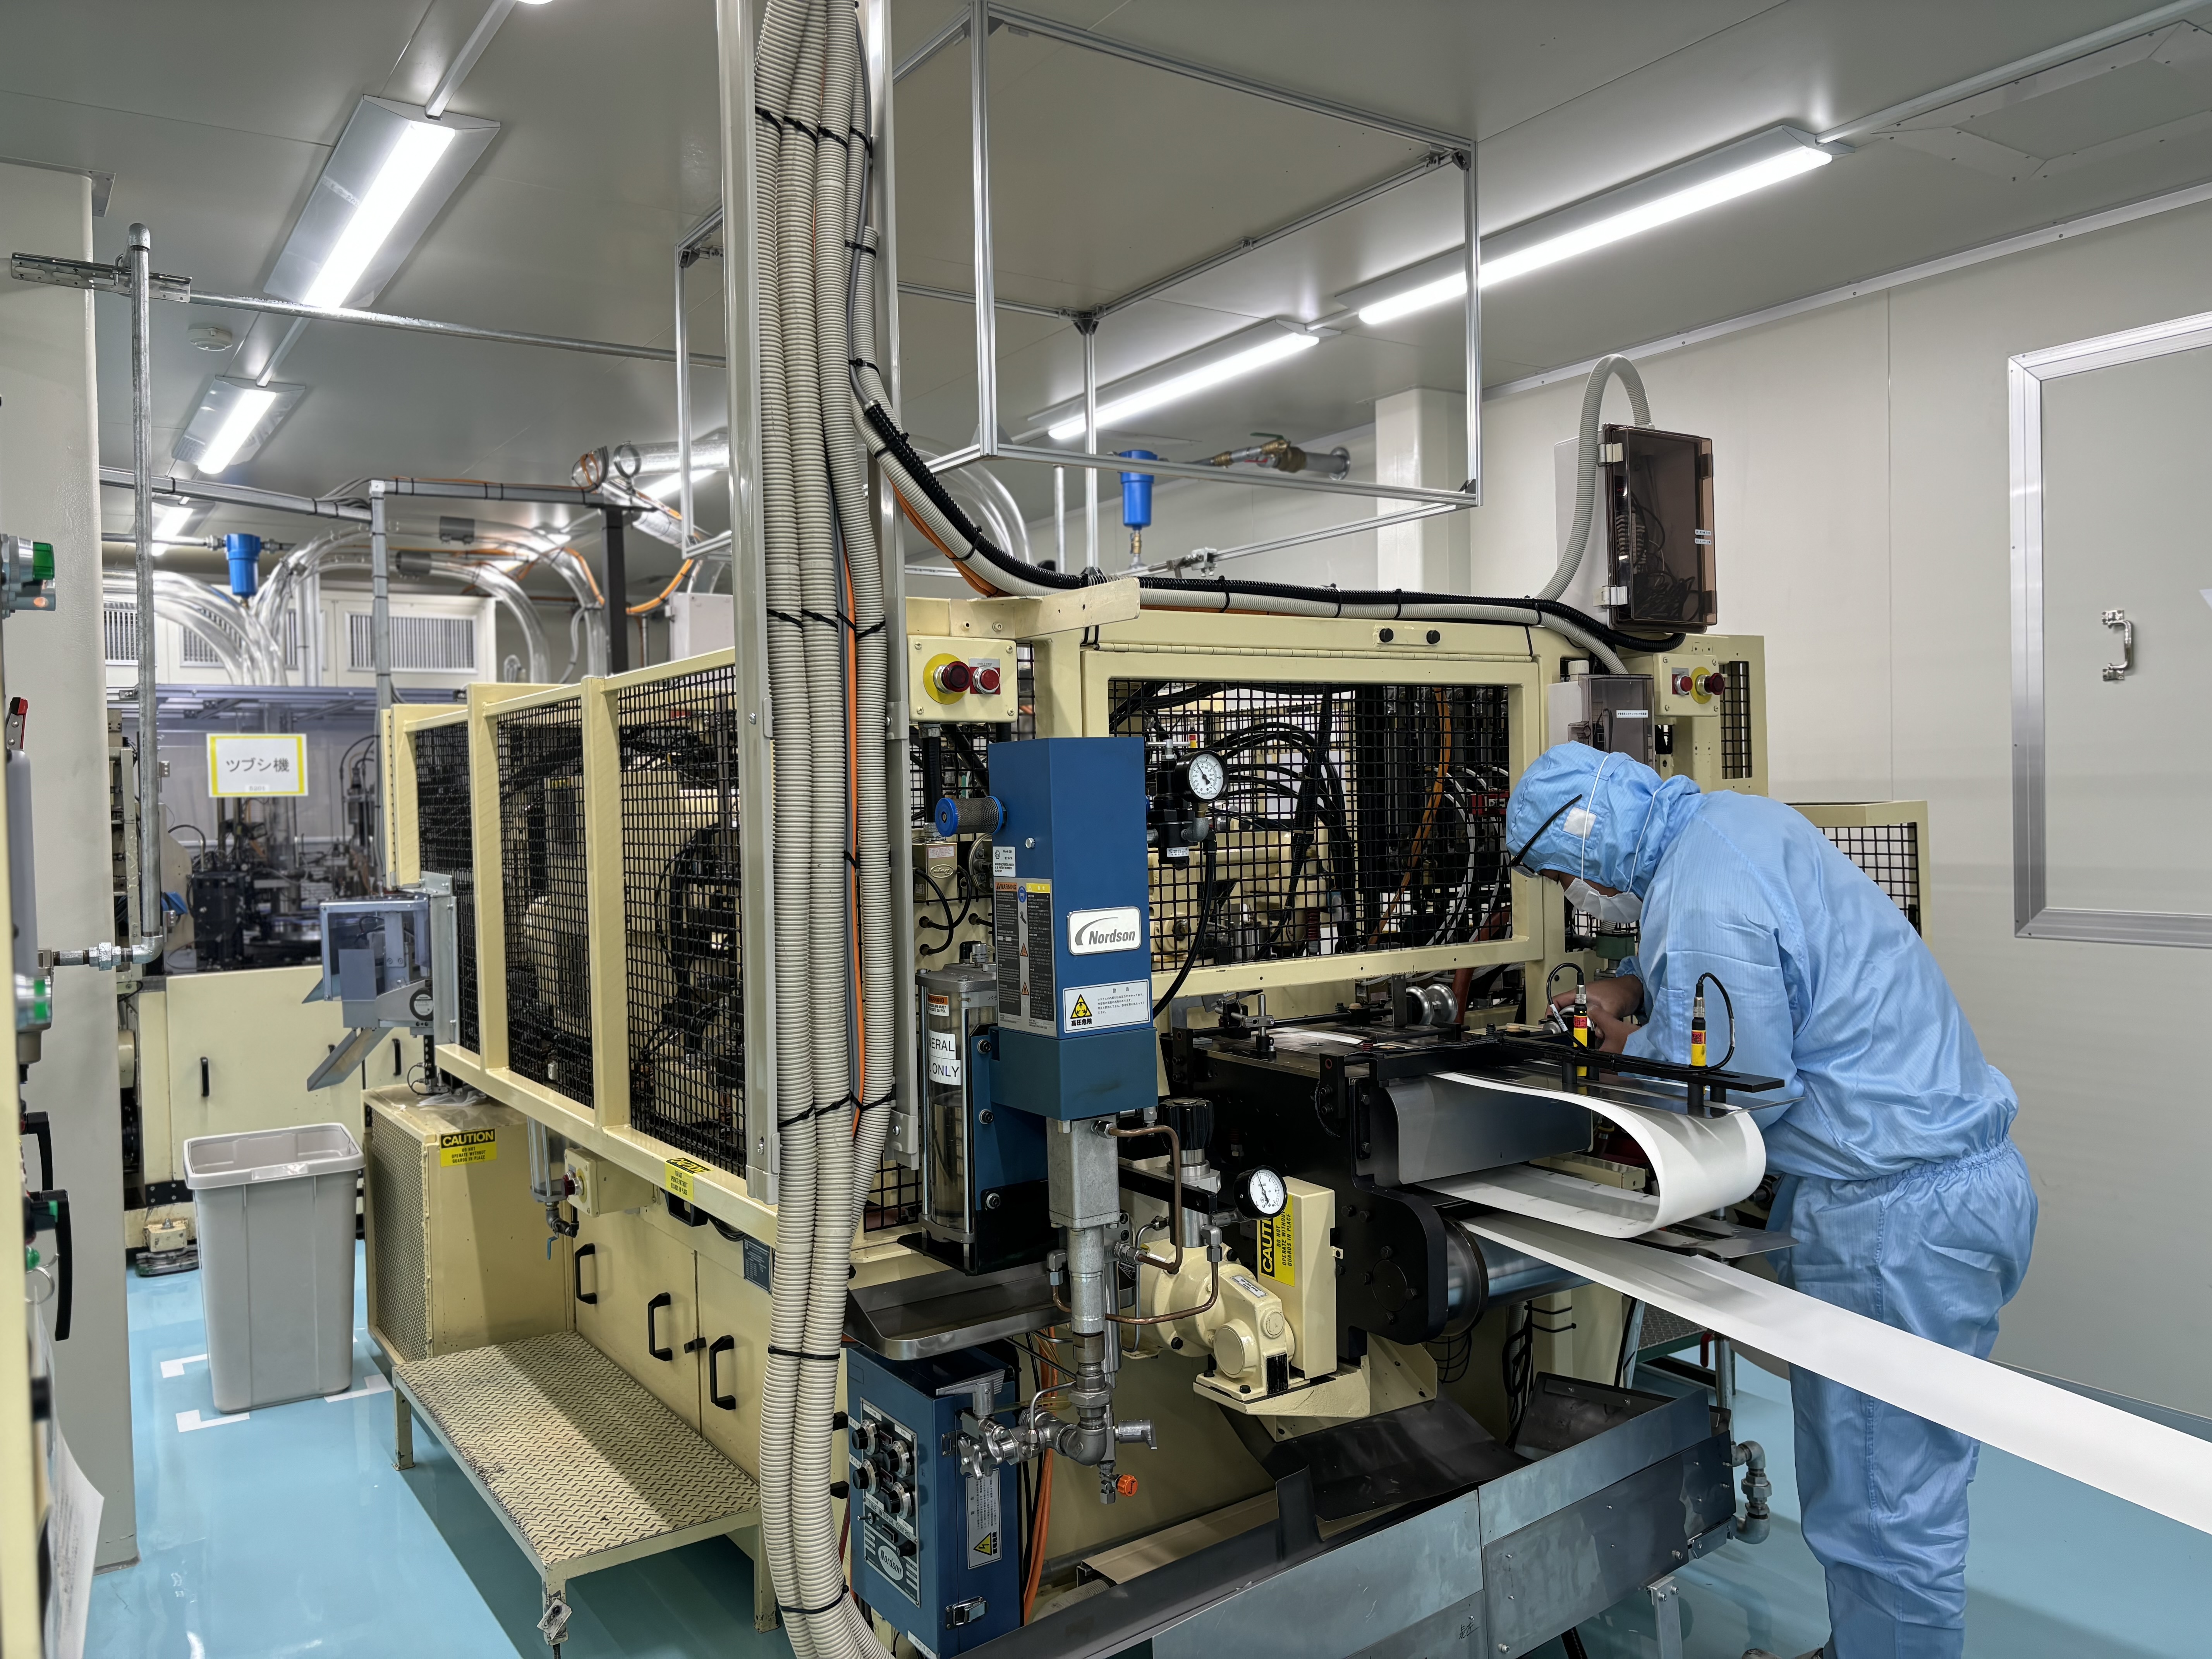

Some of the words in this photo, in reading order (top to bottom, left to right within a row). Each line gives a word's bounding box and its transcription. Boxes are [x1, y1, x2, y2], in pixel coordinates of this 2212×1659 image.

[226, 757, 289, 772] ツブシ機
[1089, 929, 1135, 945] Nordson
[1071, 1018, 1092, 1026] 高圧危険
[932, 1063, 960, 1077] ONLY
[443, 1131, 493, 1146] CAUTION
[670, 1158, 707, 1172] CAUTION
[670, 1175, 679, 1184] OPERATE
[679, 1179, 688, 1188] WITHOUT
[1262, 1219, 1273, 1273] CAUTI
[879, 1509, 894, 1526] INTERVAL
[896, 1523, 911, 1539] CONTROL
[880, 1549, 901, 1575] Nordson
